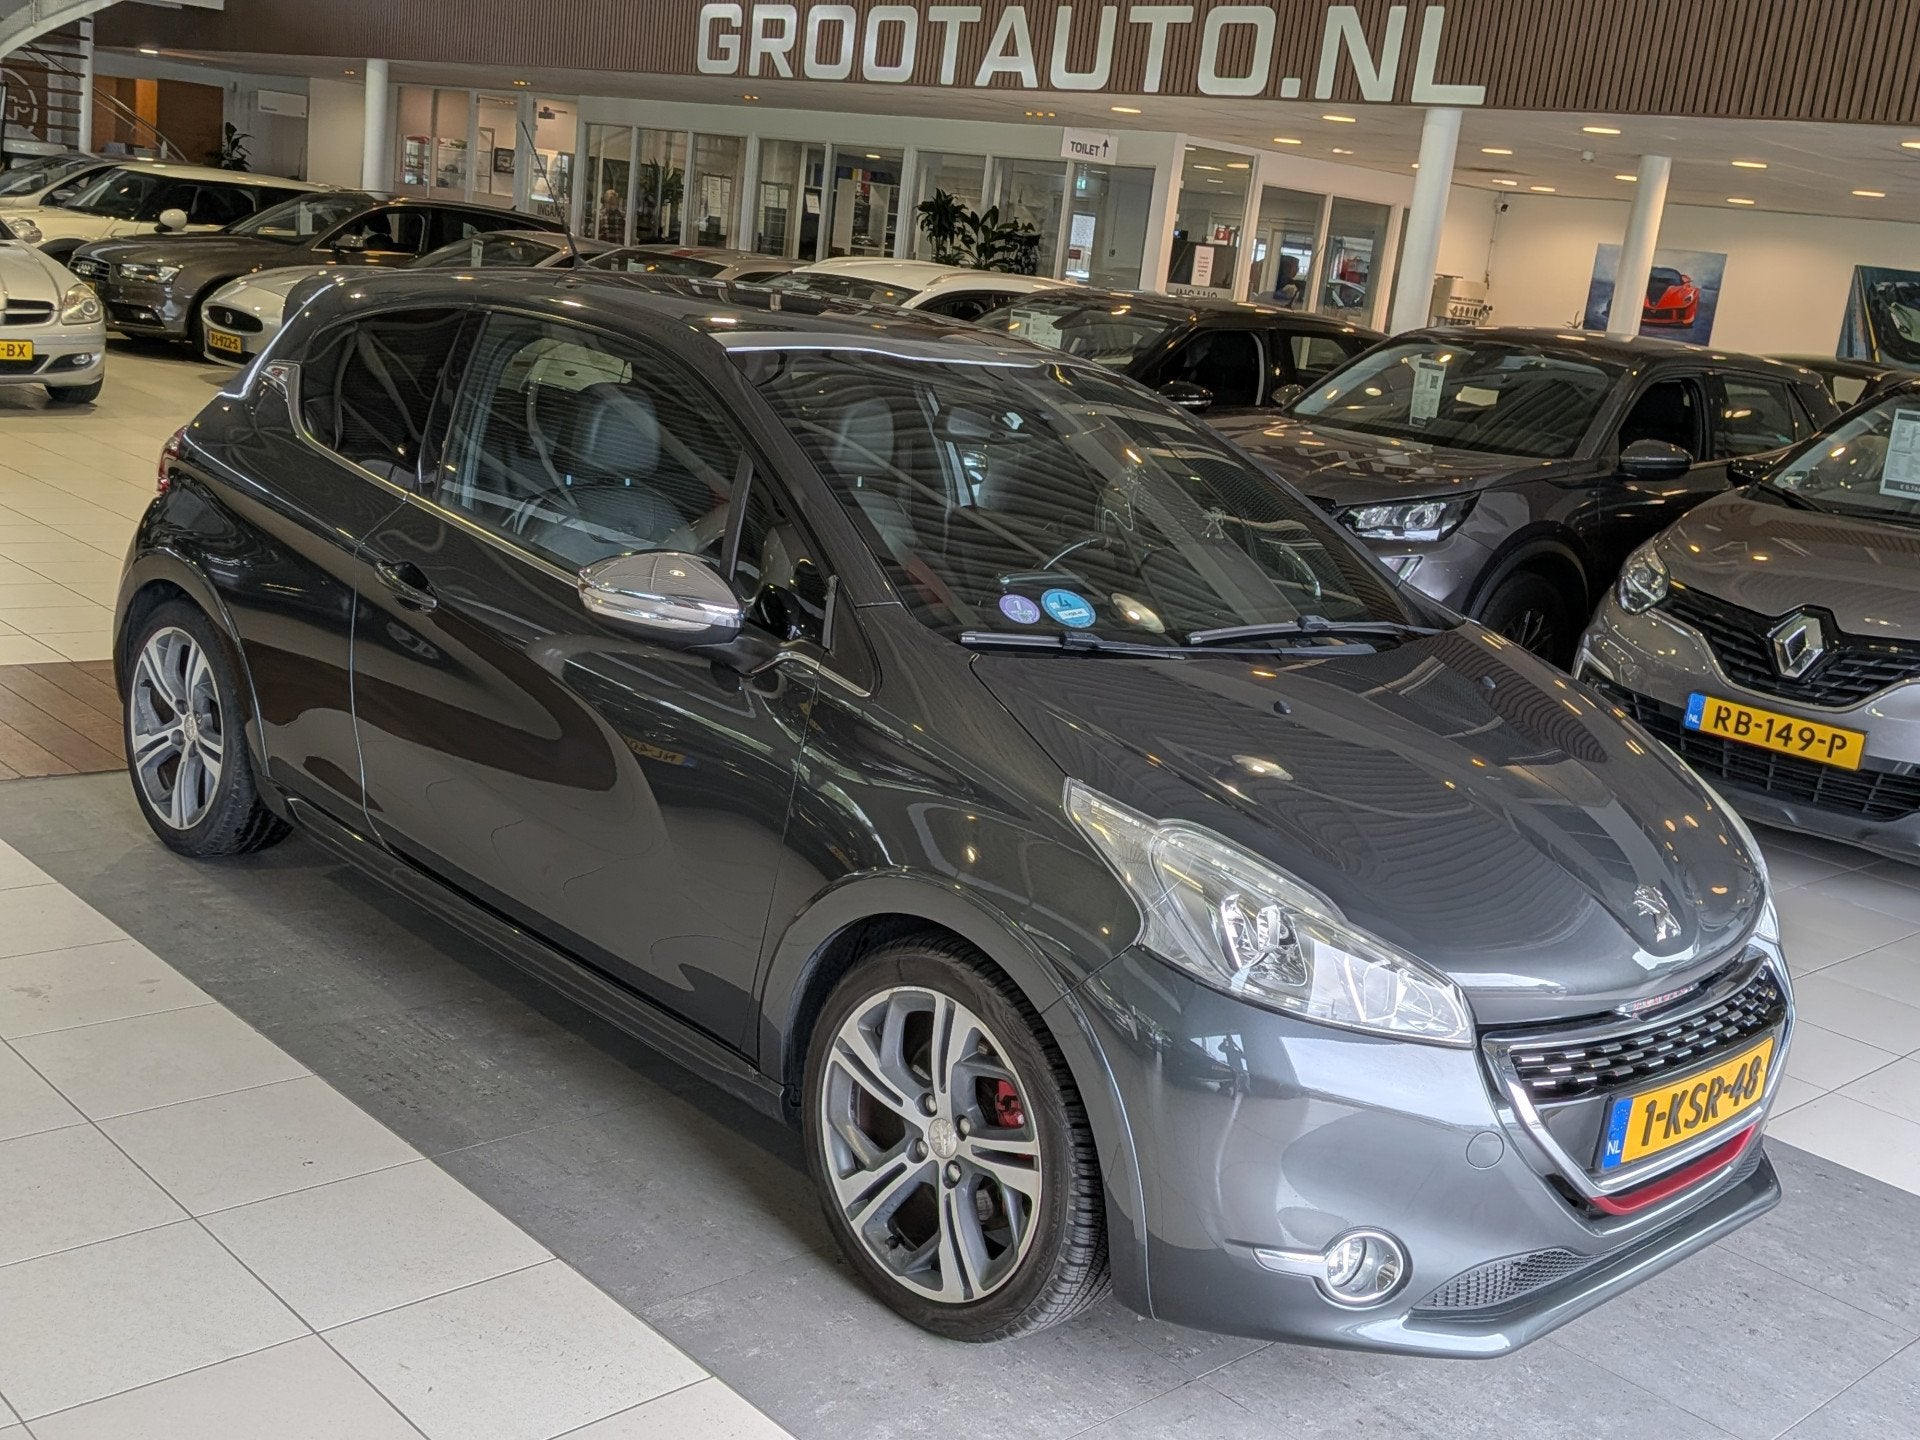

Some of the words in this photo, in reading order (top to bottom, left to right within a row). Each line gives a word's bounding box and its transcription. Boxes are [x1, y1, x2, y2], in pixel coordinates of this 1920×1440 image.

[698, 3, 1486, 105] GROOTAUTO.NL
[1070, 141, 1100, 157] TOILET
[0, 343, 26, 358] -BX
[1688, 713, 1700, 725] NL
[1713, 705, 1847, 759] RB-149-P
[1641, 1055, 1762, 1147] 1-KSR-48
[1606, 1140, 1621, 1157] NL
